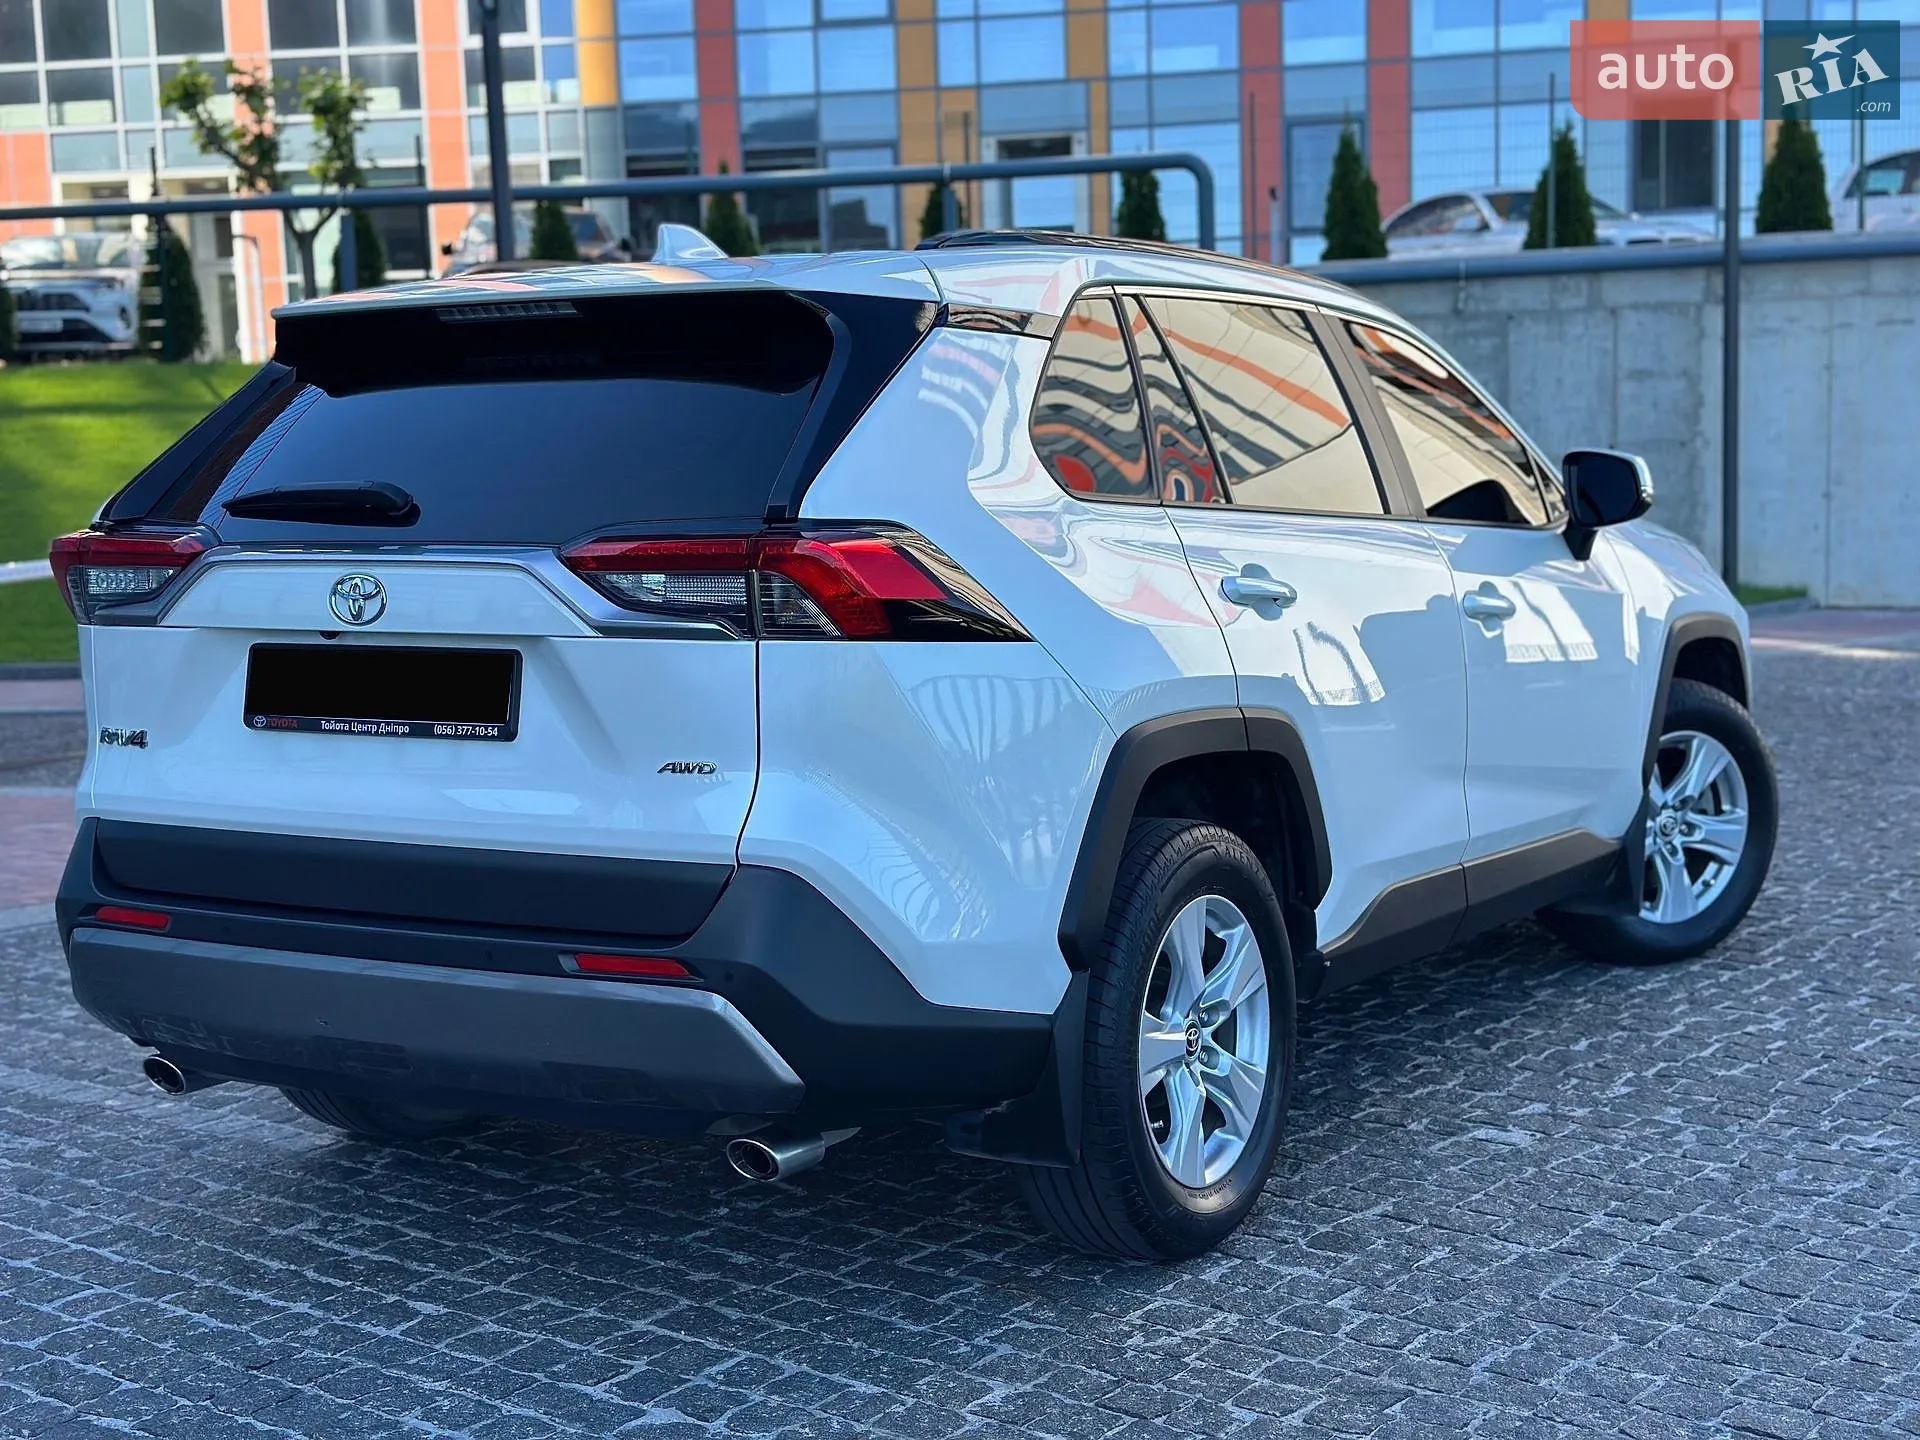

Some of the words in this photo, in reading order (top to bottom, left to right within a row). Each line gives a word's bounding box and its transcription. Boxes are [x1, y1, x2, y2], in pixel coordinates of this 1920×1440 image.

[267, 718, 298, 729] TOYOTA
[320, 720, 350, 731] Тойота
[351, 722, 377, 734] Центр
[378, 722, 410, 736] Дніпро
[433, 724, 456, 736] (056)
[456, 725, 498, 737] 377-10-54
[656, 761, 718, 774] AWD
